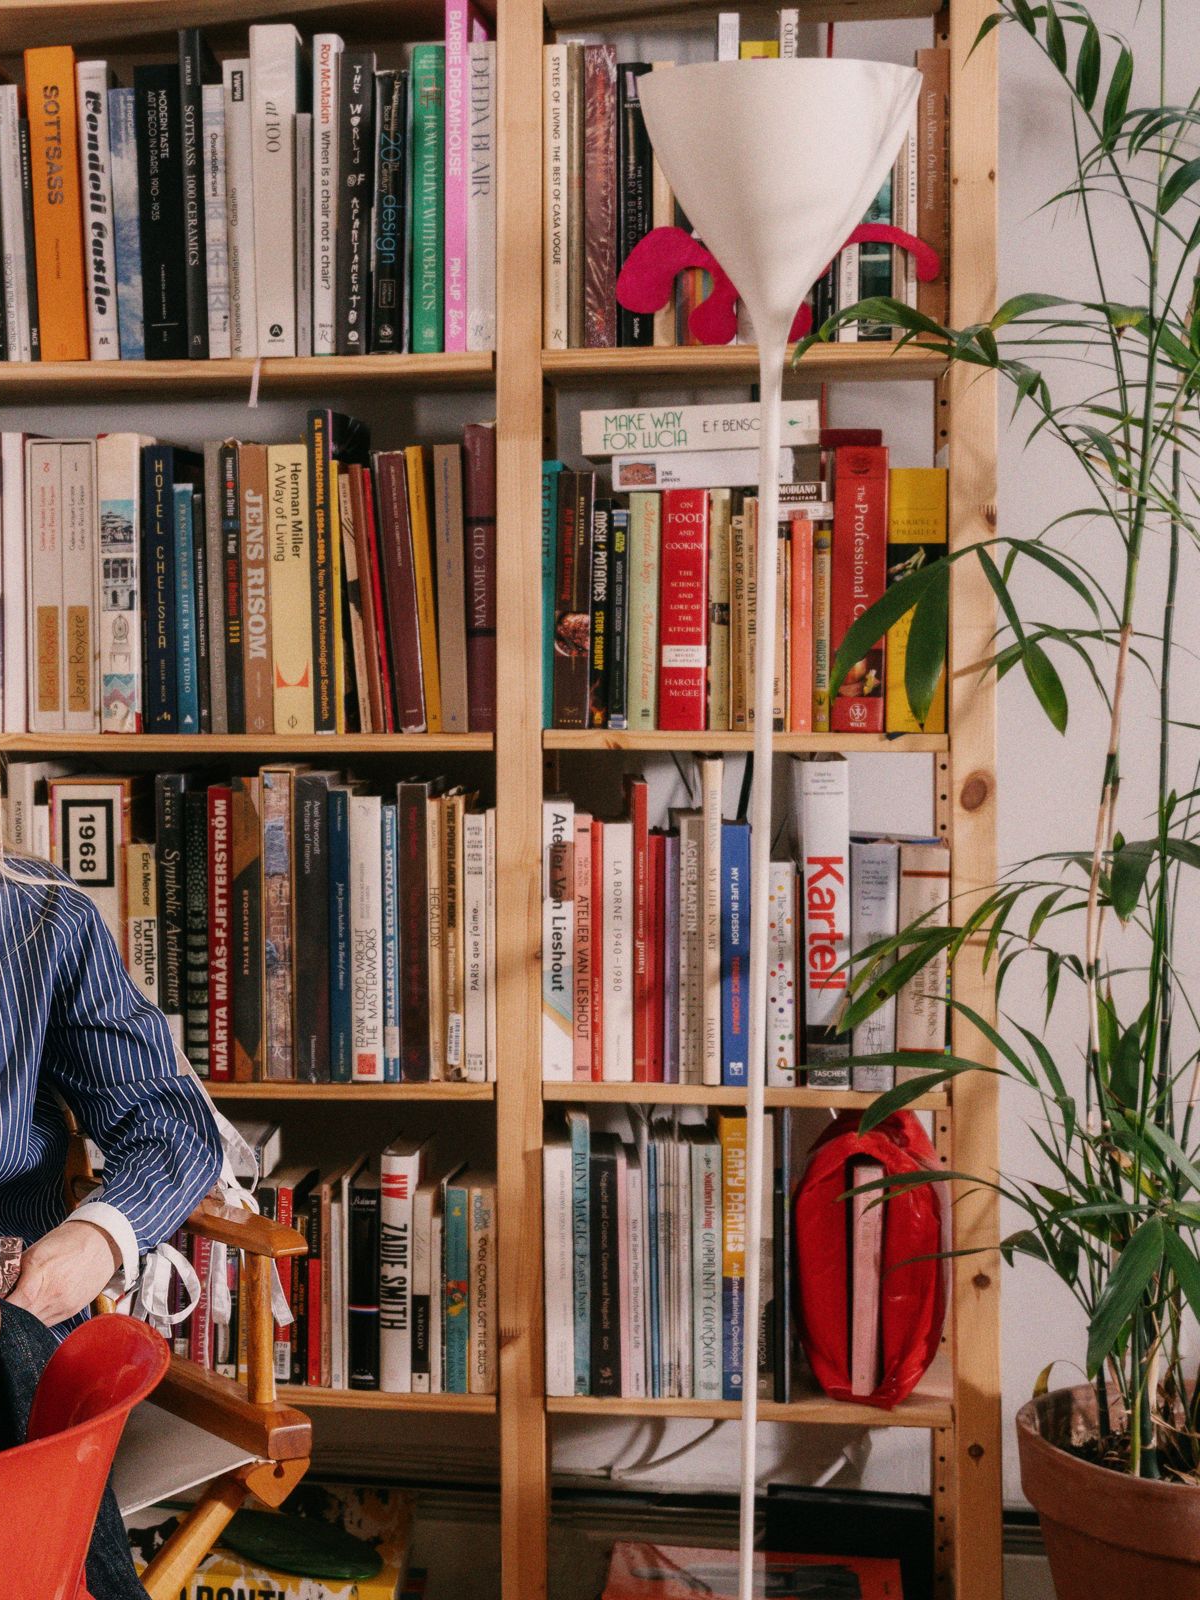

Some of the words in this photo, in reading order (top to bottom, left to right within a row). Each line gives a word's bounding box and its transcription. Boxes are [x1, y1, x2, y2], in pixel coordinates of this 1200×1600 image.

[319, 44, 331, 66] Roy
[450, 10, 462, 65] BARBIE
[233, 71, 242, 100] MoMA
[472, 56, 490, 126] DEEDA
[552, 56, 561, 87] STYLES
[159, 90, 168, 130] MODERN
[266, 101, 280, 118] at
[321, 68, 331, 124] McMakin
[552, 90, 561, 103] OF
[184, 105, 196, 166] SOTTSASS
[266, 122, 281, 152] 100
[450, 68, 462, 175] DREAMHOUSE
[552, 108, 561, 139] LIVING
[42, 86, 64, 205] SOTTSASS
[85, 91, 108, 214] Wendell
[160, 132, 169, 158] TASTE
[472, 133, 490, 196] BLAIR
[552, 146, 561, 163] THE
[187, 174, 197, 198] 1000
[552, 166, 561, 186] BEST
[552, 188, 561, 201] OF
[187, 202, 199, 266] CERAMICS
[552, 204, 561, 229] CASA
[552, 231, 562, 265] VOGUE
[90, 222, 112, 315] Castle
[232, 246, 241, 300] Constellation
[234, 302, 242, 344] Japanese
[314, 418, 323, 430] EL
[602, 431, 636, 450] FOR
[642, 429, 687, 448] LUCIA
[604, 414, 645, 430] MAKE
[650, 411, 683, 428] WAY
[703, 420, 709, 433] E
[714, 419, 718, 432] F
[722, 417, 760, 432] BENSO
[275, 463, 285, 474] A
[315, 432, 324, 506] INTERNACIONAL
[273, 476, 286, 505] Way
[290, 462, 302, 517] Herman
[778, 484, 816, 494] MODIANO
[857, 486, 865, 501] The
[244, 489, 265, 560] JENS
[276, 508, 286, 519] of
[593, 511, 606, 542] MOSH
[668, 514, 705, 523] FOOD
[273, 523, 287, 561] Living
[291, 520, 302, 558] Miller
[472, 528, 485, 559] OLD
[853, 503, 868, 598] Professional
[593, 551, 606, 601] POTATOES
[247, 568, 267, 659] RISOM
[473, 566, 487, 627] MAXIME
[69, 614, 87, 663] Royère
[665, 678, 704, 686] HAROLD
[816, 639, 826, 688] HOUSEPLANT
[69, 670, 86, 704] Jean
[669, 689, 699, 697] McGEE
[385, 810, 394, 846] Braun
[448, 804, 456, 821] THE
[79, 814, 96, 873] 1968
[448, 824, 456, 858] POWER
[552, 813, 567, 871] Atelier
[687, 840, 697, 880] AGNES
[164, 849, 182, 914] Symbolic
[448, 860, 456, 886] LOOK
[613, 861, 622, 876] LA
[211, 800, 228, 1000] MÅÅS-FJETTERSTRÖM
[385, 849, 394, 936] MINIATURE
[448, 887, 456, 899] AT
[552, 875, 566, 909] Van
[613, 881, 622, 920] BORNE
[687, 884, 697, 931] MARTIN
[429, 887, 440, 949] HERALDRY
[448, 902, 456, 928] HOME
[577, 894, 589, 943] ATELIER
[806, 856, 848, 989] Kartell
[144, 919, 157, 985] Furniture
[166, 920, 184, 1006] Architecture
[356, 928, 364, 972] WRIGHT
[552, 916, 567, 991] Lieshout
[577, 949, 589, 976] VAN
[366, 929, 377, 1018] MASTERWORKS
[385, 940, 394, 1026] VIGNETTES
[356, 977, 364, 1010] LLOYD
[577, 979, 589, 1040] LIESHOUT
[356, 1018, 364, 1047] FRANK
[732, 996, 740, 1034] CONRAN
[212, 1006, 227, 1071] MÄRTA
[366, 1026, 376, 1047] THE
[706, 1018, 715, 1057] HARPER
[382, 1173, 408, 1199] NW
[575, 1152, 586, 1193] PAINT
[727, 1148, 745, 1187] ARTY
[576, 1199, 586, 1246] MAGIC
[727, 1192, 746, 1252] PARTIES
[381, 1222, 408, 1268] ZADIE
[702, 1233, 716, 1303] COMMUNITY
[381, 1275, 408, 1330] SMITH
[702, 1307, 716, 1370] COOKBOOK
